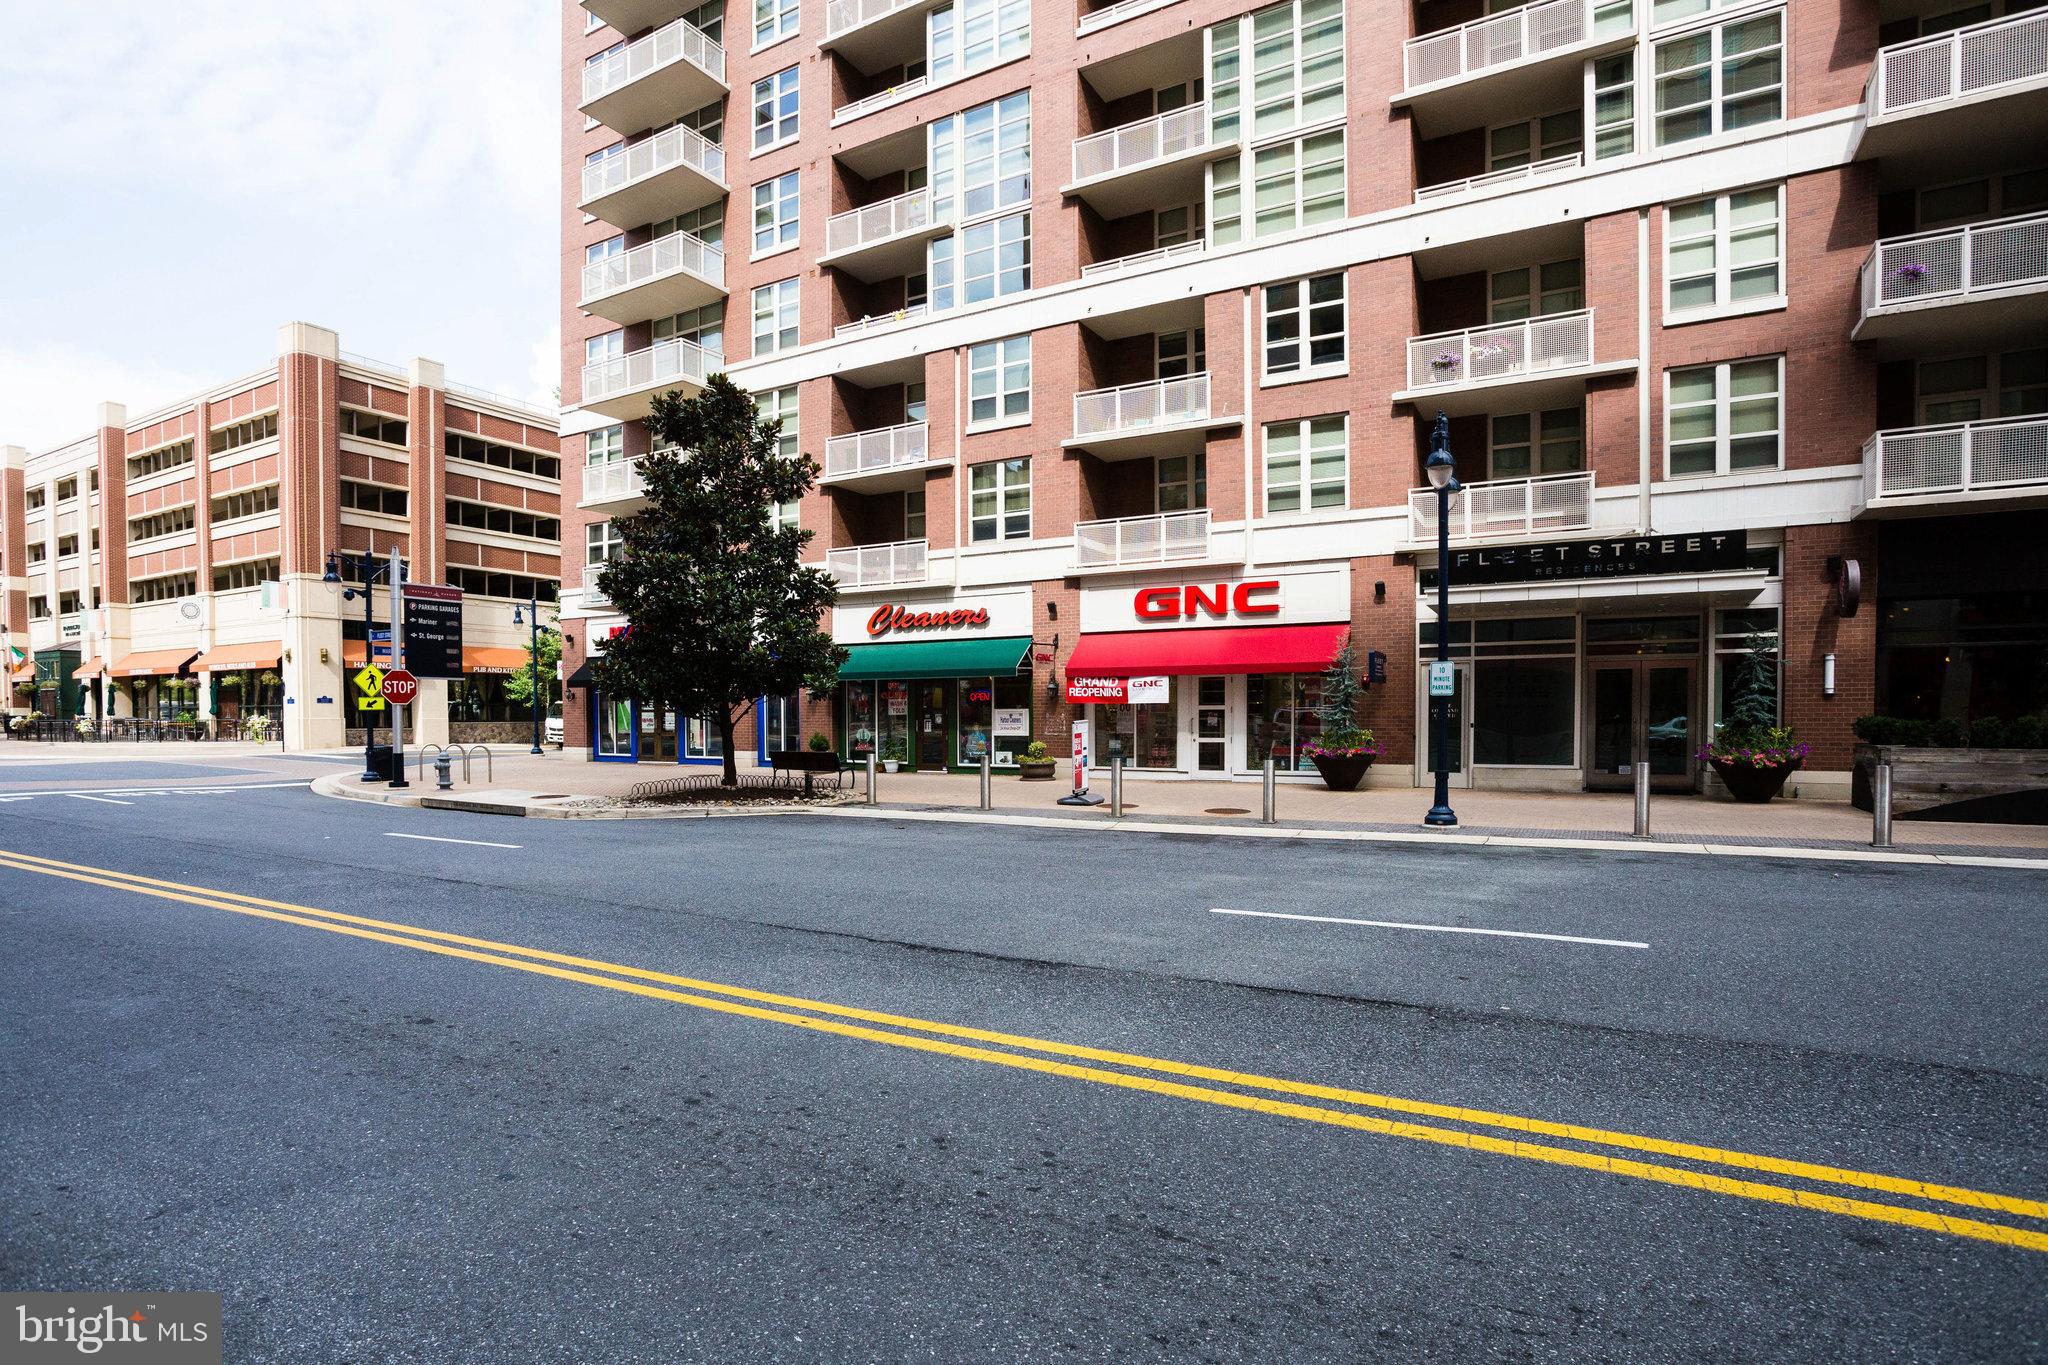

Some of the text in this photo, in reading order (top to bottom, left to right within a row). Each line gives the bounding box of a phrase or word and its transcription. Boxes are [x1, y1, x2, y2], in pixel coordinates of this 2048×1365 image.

[1457, 536, 1727, 567] FLEET STREET
[1134, 580, 1280, 619] GNC
[418, 603, 439, 611] PARKING
[439, 605, 460, 613] GARAGES
[418, 617, 438, 626] Mariner
[866, 603, 989, 635] Cleaners
[426, 632, 445, 641] George
[1036, 653, 1054, 662] GNC
[1439, 666, 1446, 674] 10
[383, 680, 415, 694] STOP
[1074, 676, 1119, 688] GRAND
[1132, 679, 1164, 688] GNC
[969, 692, 990, 702] OPEN
[1068, 687, 1123, 697] REOPENING
